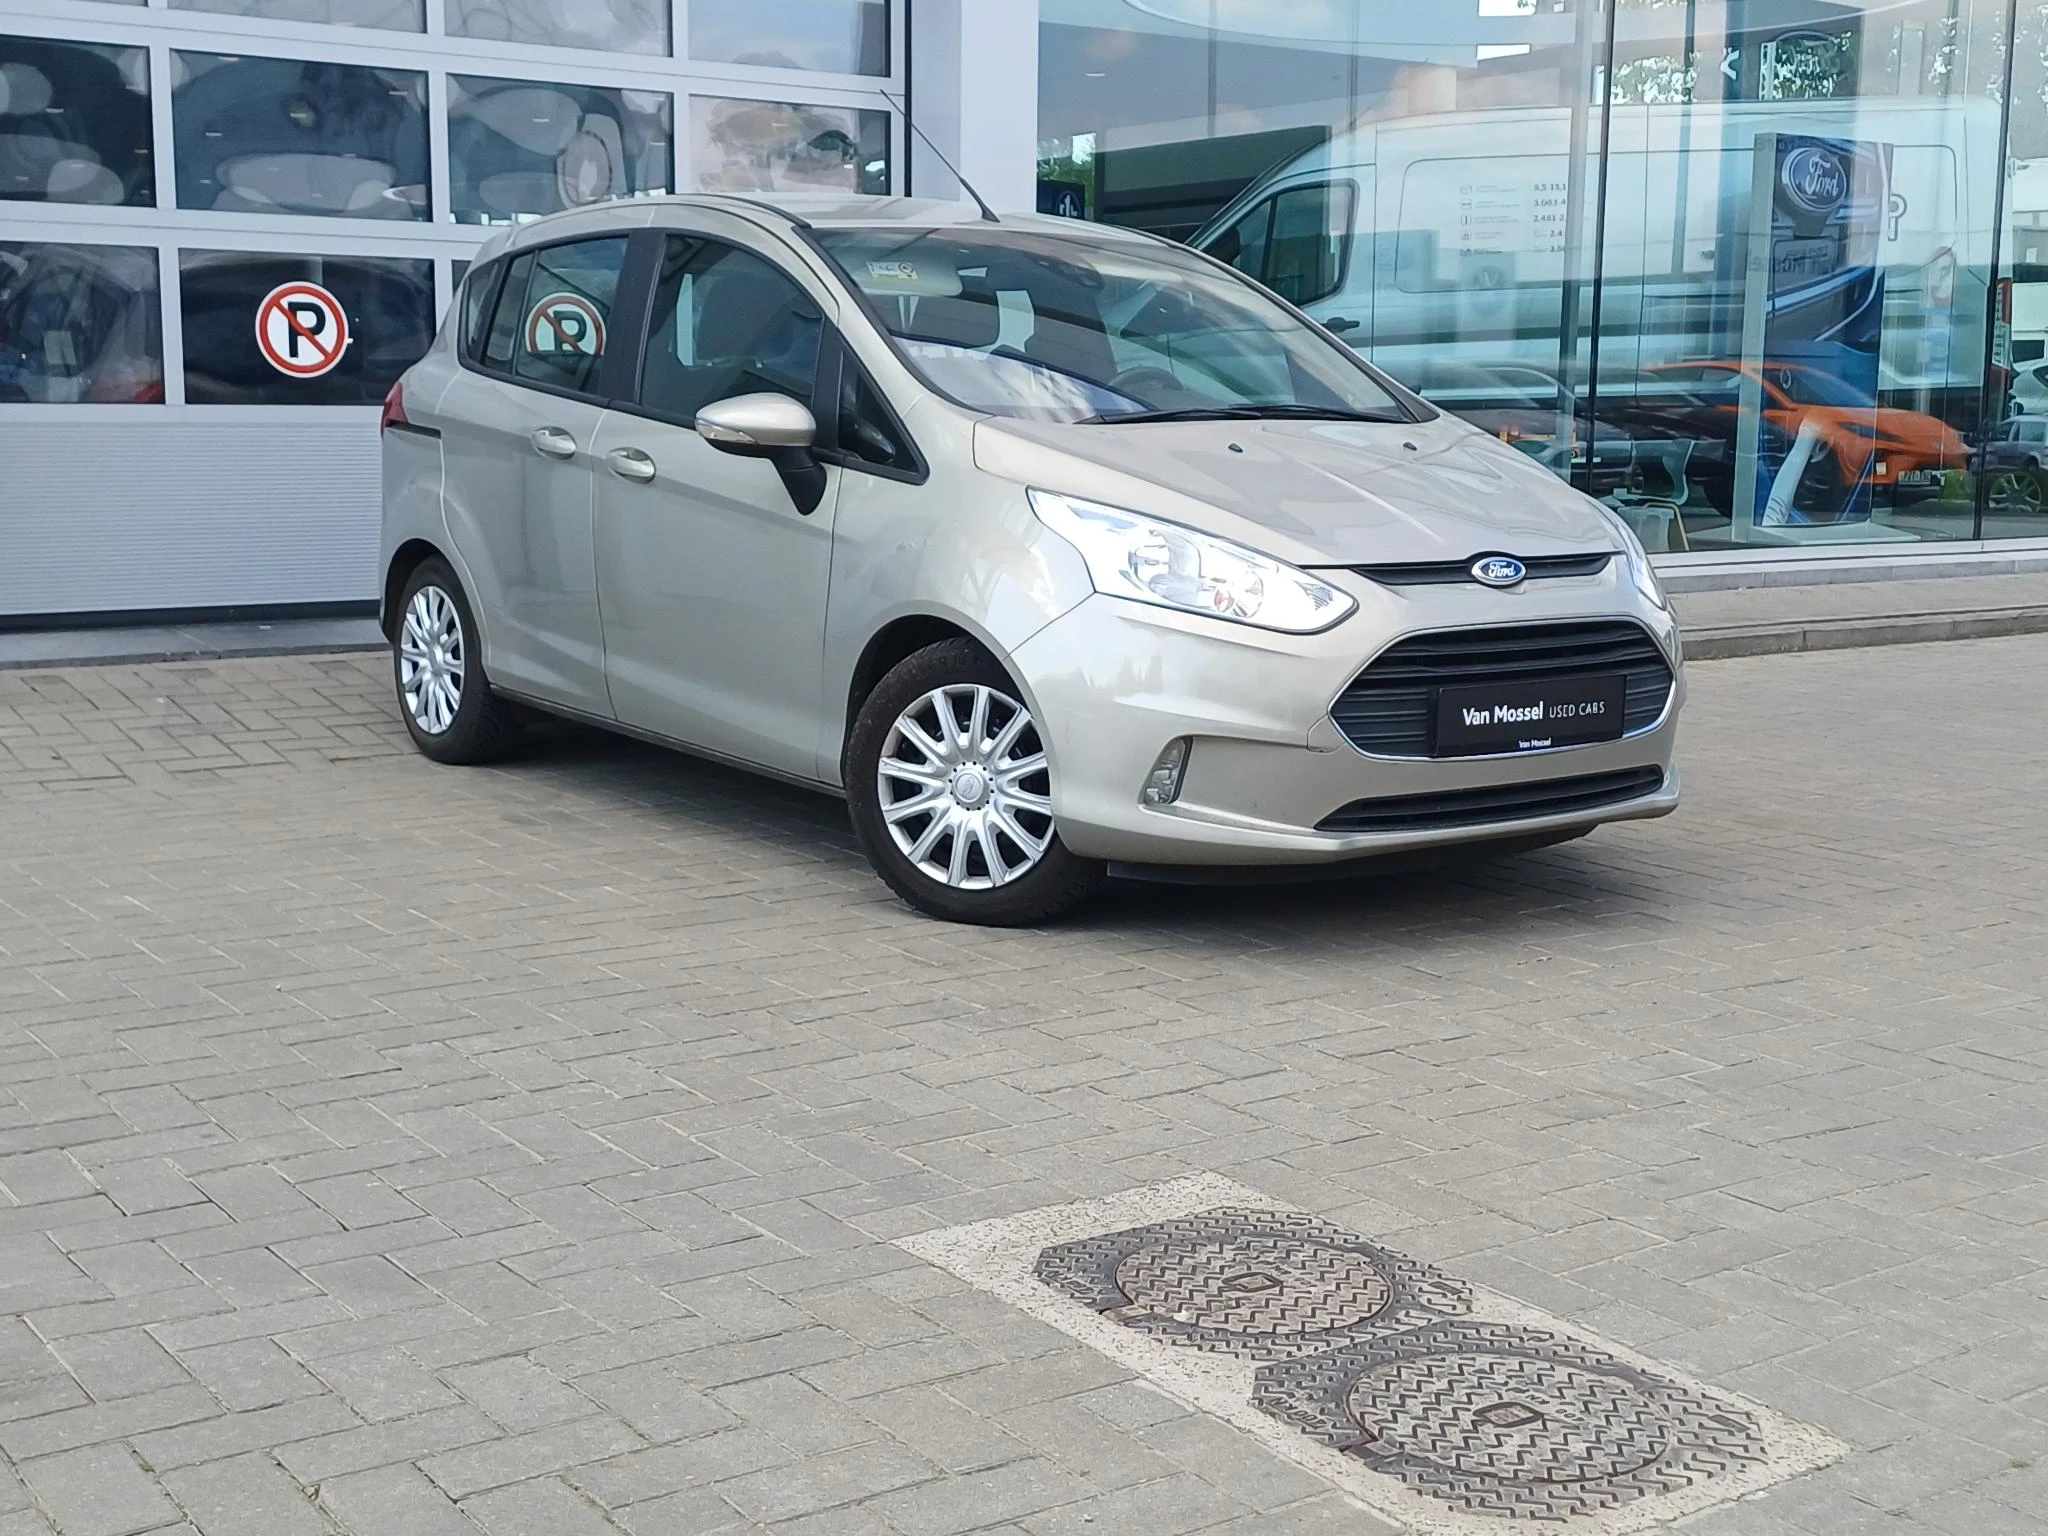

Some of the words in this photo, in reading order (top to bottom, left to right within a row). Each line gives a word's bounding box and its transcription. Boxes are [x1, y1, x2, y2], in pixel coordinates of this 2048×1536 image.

[1805, 153, 1839, 197] Ford
[287, 301, 326, 358] P
[1488, 561, 1516, 578] Ford
[1462, 707, 1490, 726] Van
[1493, 700, 1544, 724] Mossel
[1549, 704, 1576, 719] USED
[1578, 701, 1605, 716] CARS
[1518, 738, 1531, 749] Van
[1531, 736, 1552, 748] Mossel
